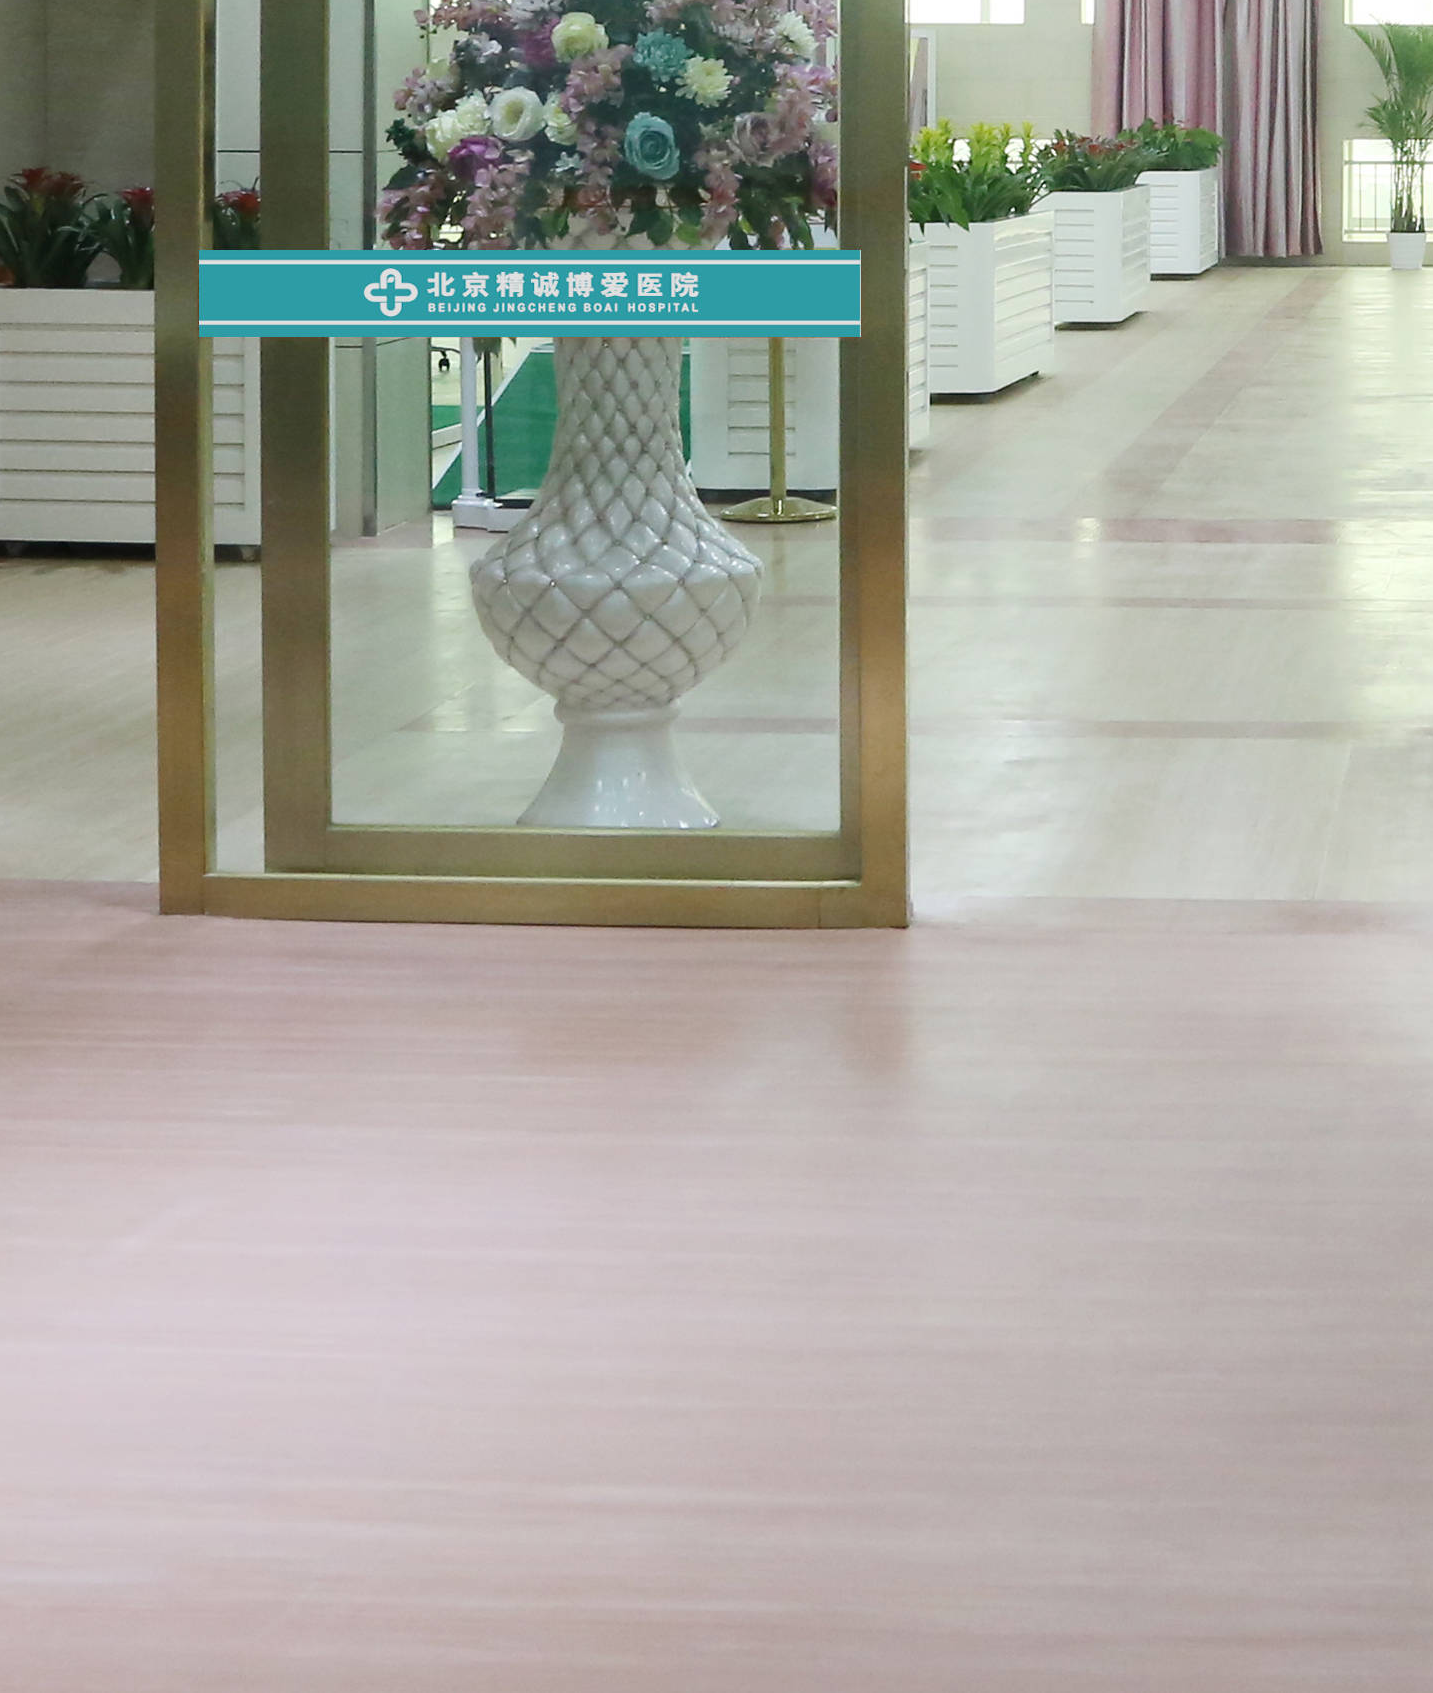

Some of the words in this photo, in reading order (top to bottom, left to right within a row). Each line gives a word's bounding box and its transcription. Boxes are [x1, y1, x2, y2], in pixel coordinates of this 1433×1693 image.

[427, 271, 700, 298] 北京精诚博爱医院
[428, 302, 487, 313] BEIJING
[492, 302, 577, 313] JINGCHENG
[583, 302, 619, 313] BOAI
[628, 302, 699, 313] HOSPITAL
